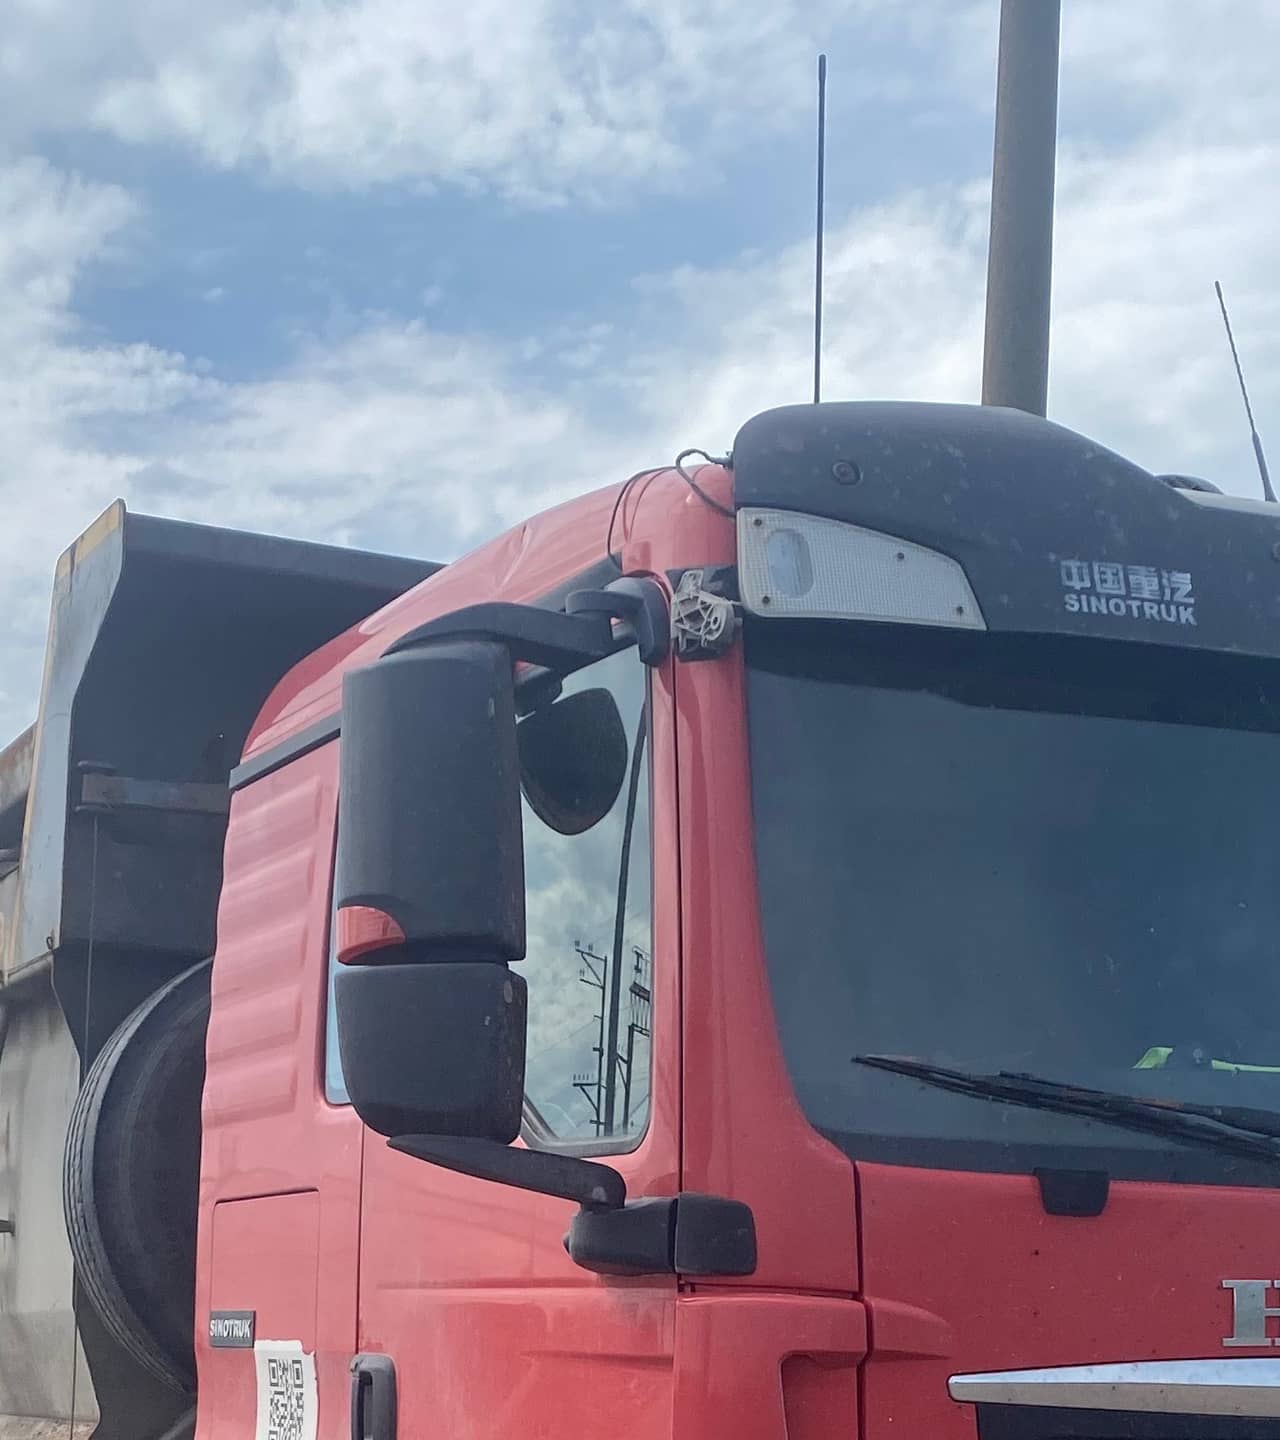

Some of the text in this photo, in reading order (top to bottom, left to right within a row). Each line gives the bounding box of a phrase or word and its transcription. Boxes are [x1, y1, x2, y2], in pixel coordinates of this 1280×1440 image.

[1060, 559, 1195, 604] 中国重汽
[1064, 593, 1198, 626] SINOTRUK
[209, 1319, 252, 1338] SINOTRUK
